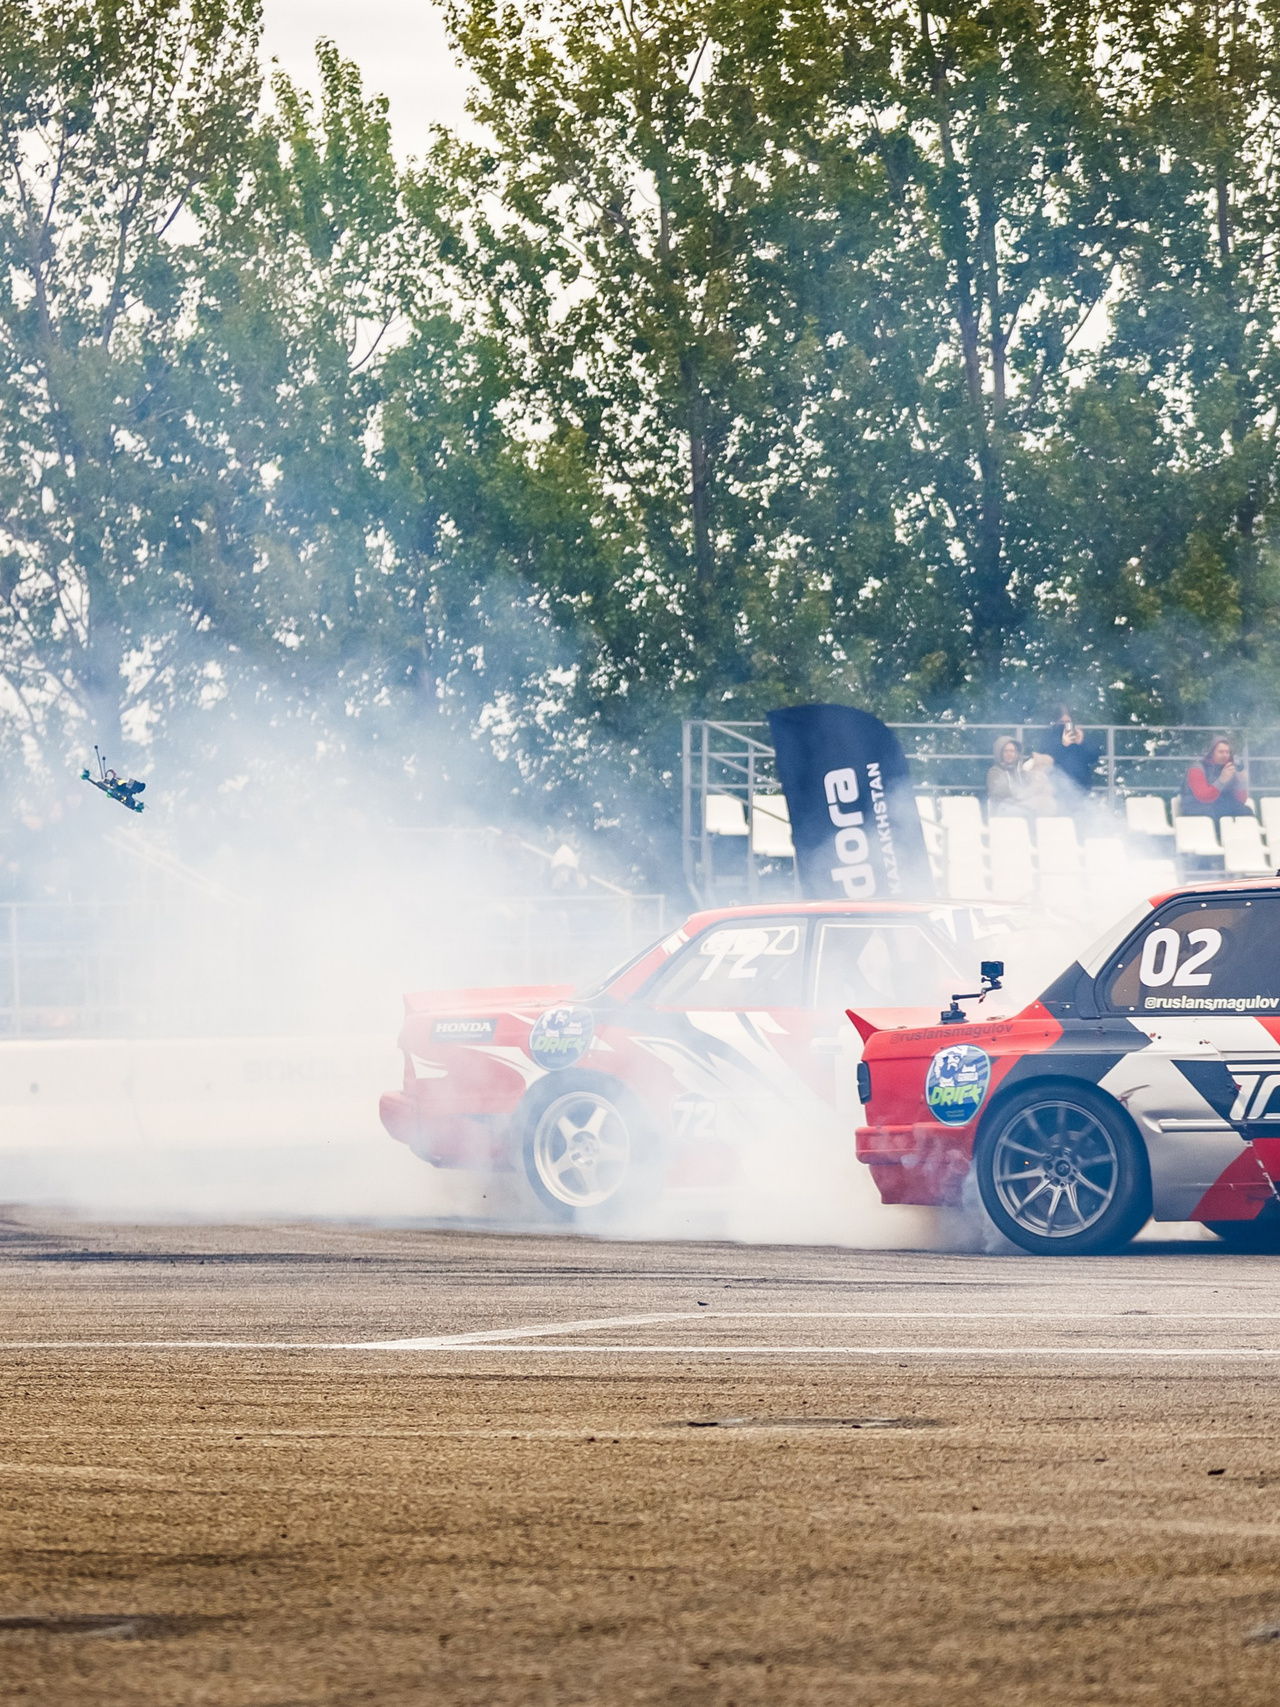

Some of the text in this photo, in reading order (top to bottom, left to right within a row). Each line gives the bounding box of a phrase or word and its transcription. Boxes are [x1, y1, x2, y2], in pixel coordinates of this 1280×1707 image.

[824, 767, 876, 899] dora
[866, 762, 902, 895] KAZAKHSTAN
[1139, 928, 1222, 987] 02
[435, 1022, 492, 1033] HONDA
[671, 1101, 717, 1138] 72
